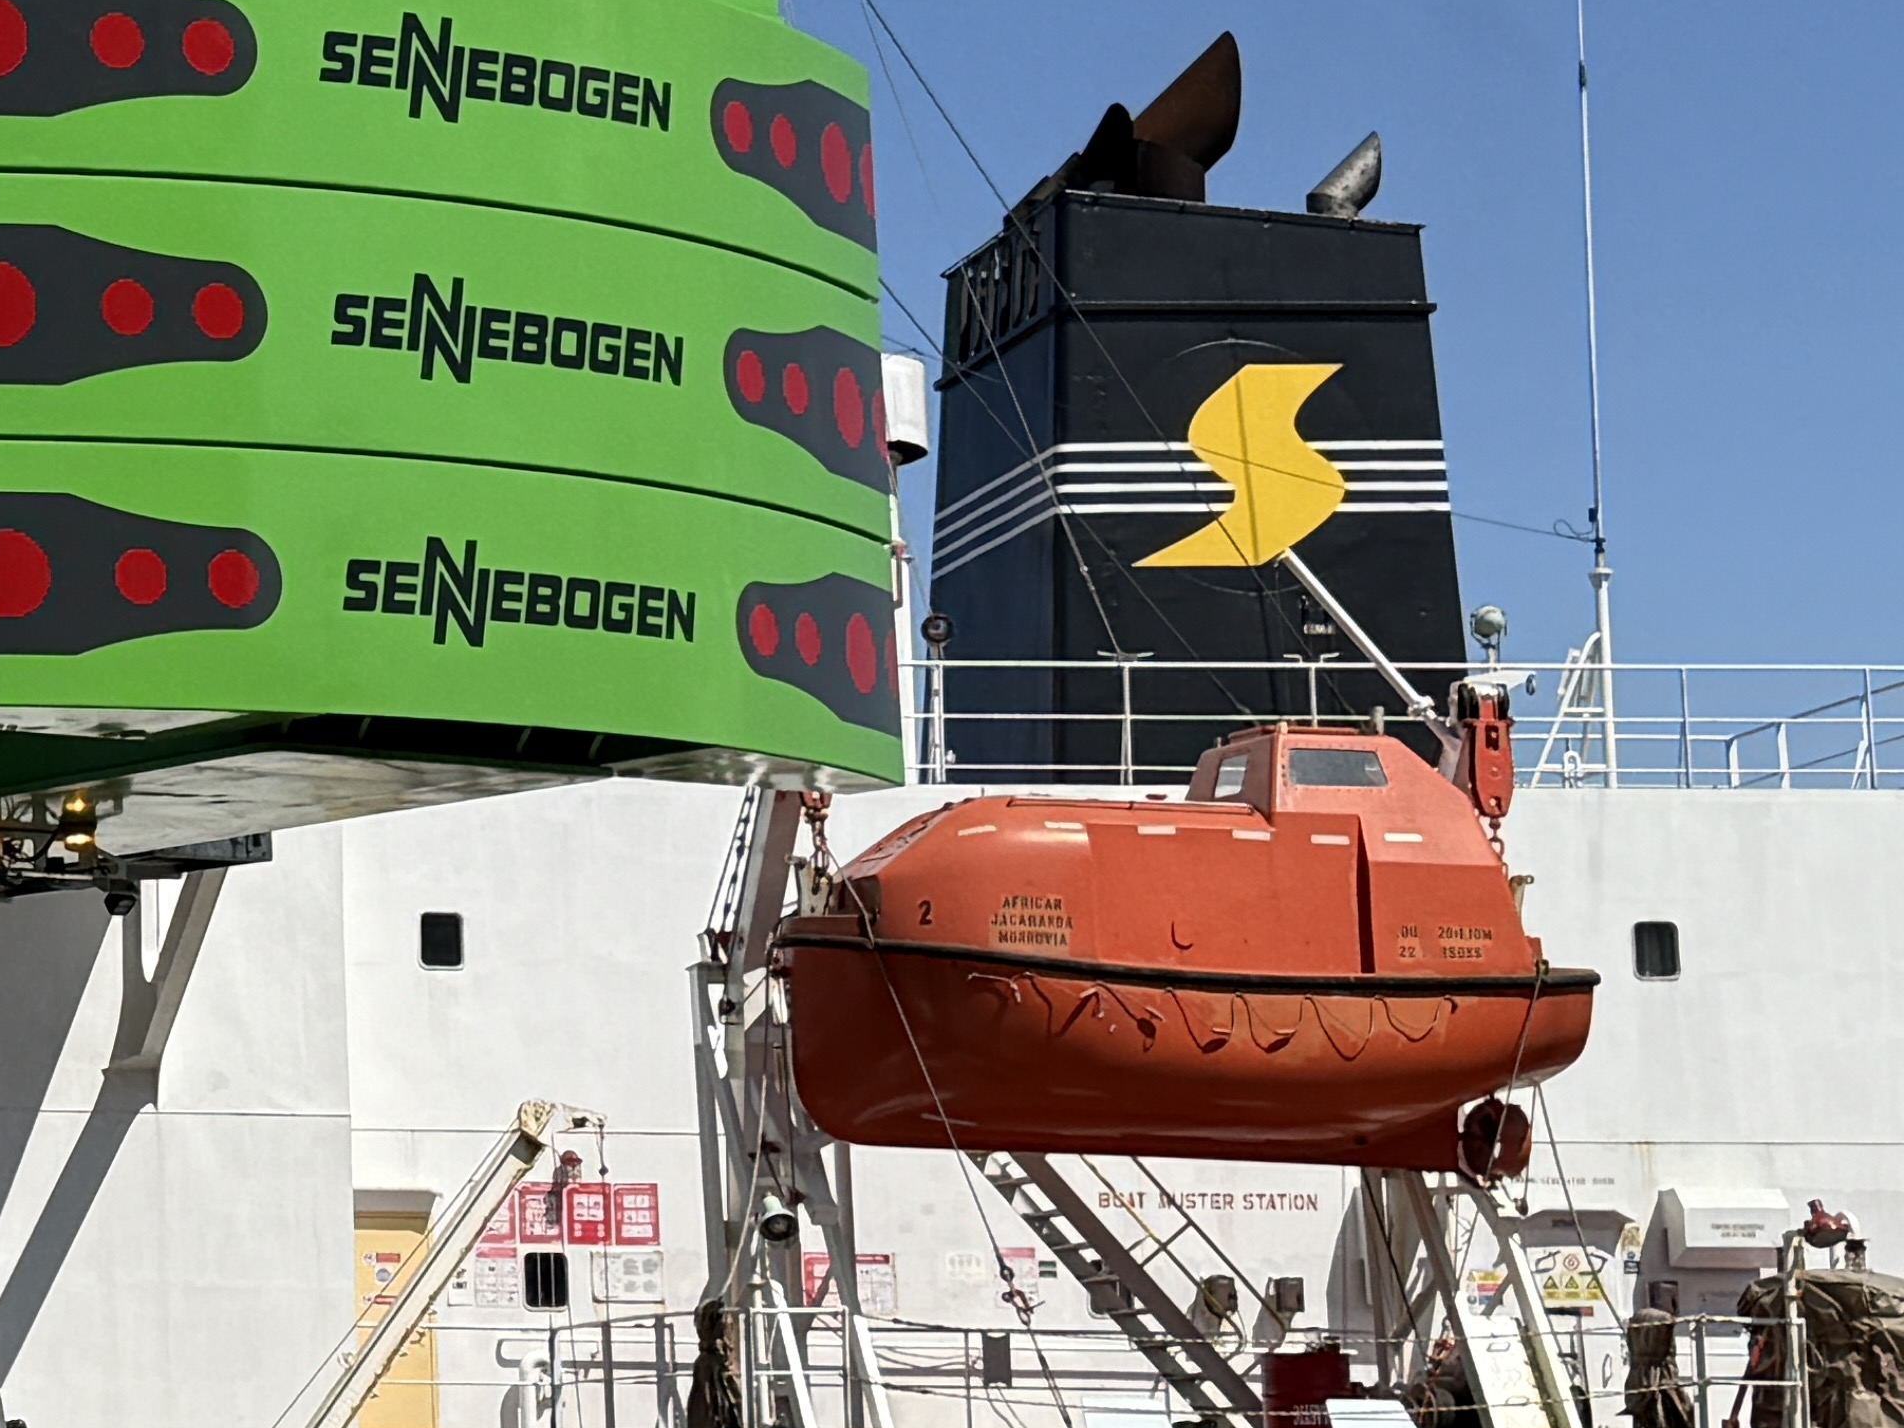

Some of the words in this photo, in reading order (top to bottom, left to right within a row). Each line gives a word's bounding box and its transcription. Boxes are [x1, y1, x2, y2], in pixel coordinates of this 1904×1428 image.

[319, 12, 673, 134] SENNEBOGEN
[330, 272, 684, 388] SENNEBOGEN
[342, 536, 697, 650] SENNEBOGEN
[917, 899, 933, 926] 2
[1002, 895, 1063, 912] AFRICAN
[1097, 1191, 1147, 1210] BOAT
[1158, 1191, 1235, 1211] MUSTER
[1242, 1192, 1319, 1212] STATION
